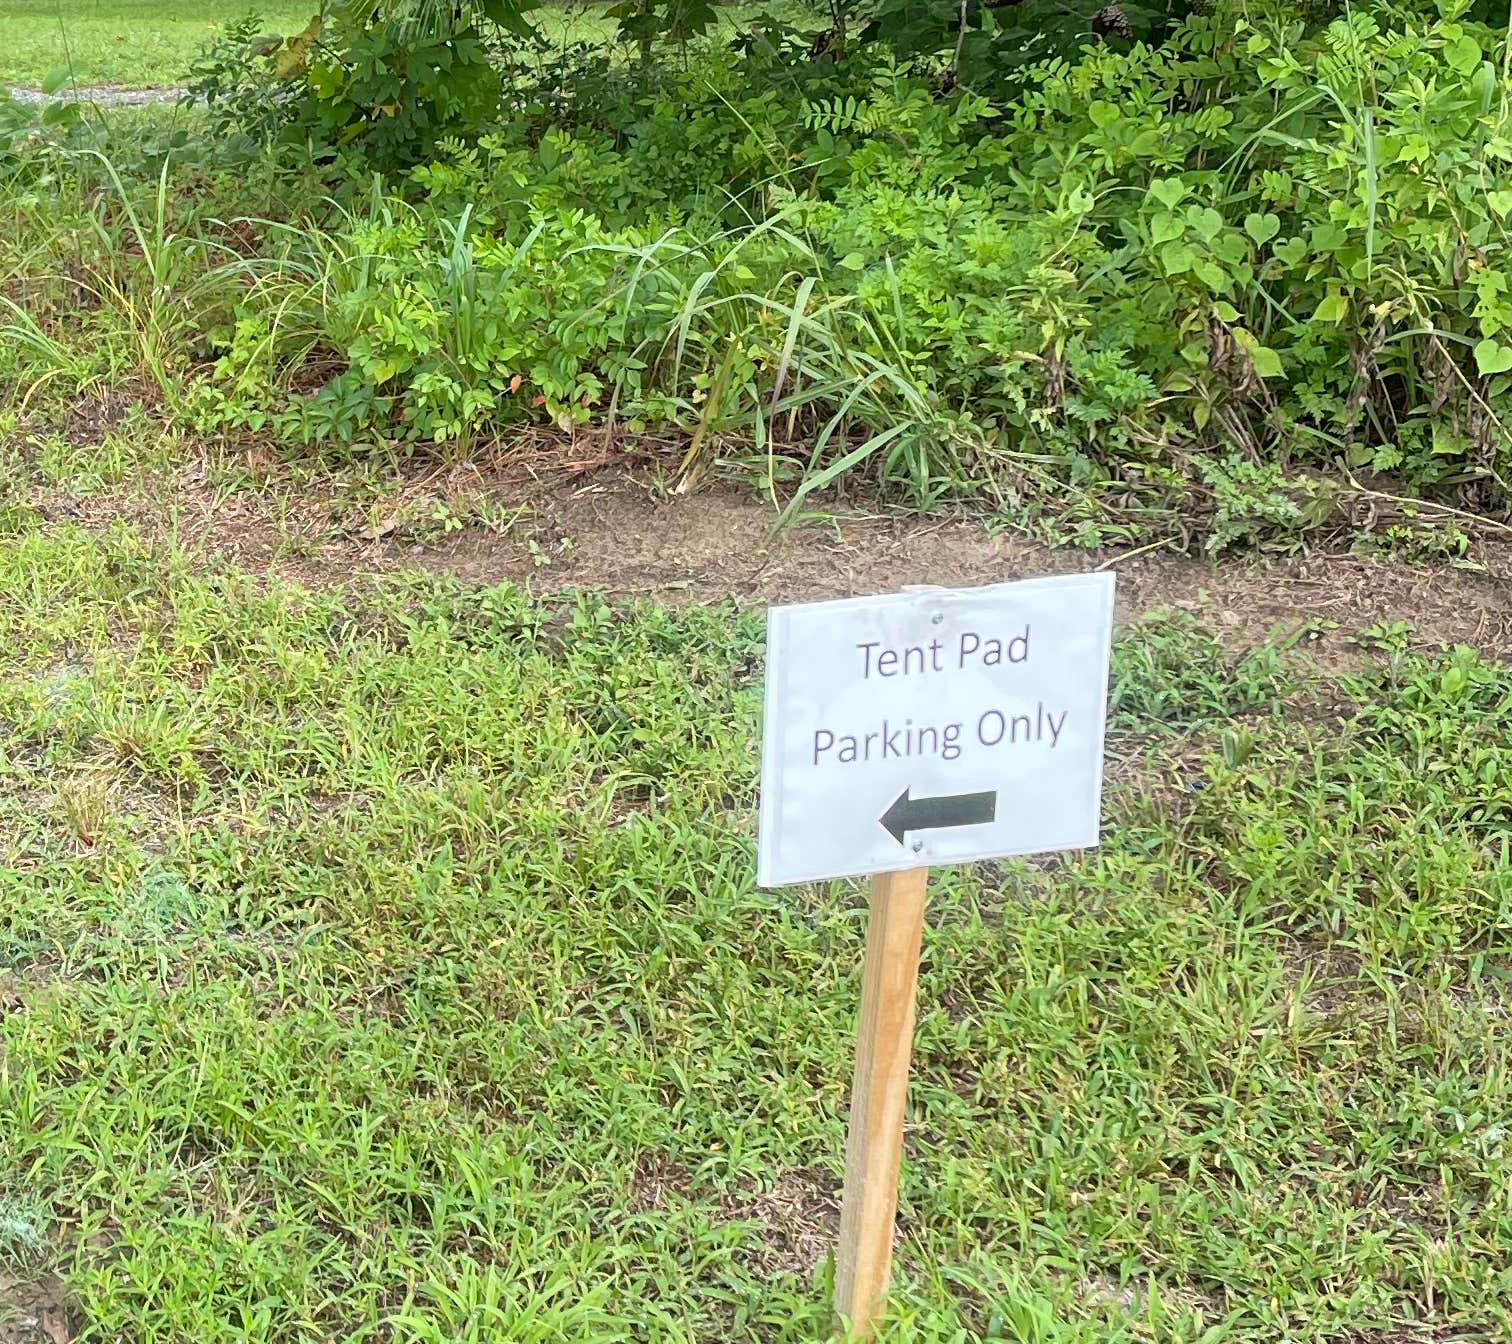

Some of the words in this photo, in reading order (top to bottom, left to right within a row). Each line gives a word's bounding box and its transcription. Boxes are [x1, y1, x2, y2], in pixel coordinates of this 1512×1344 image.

[856, 638, 943, 679] Tent
[958, 624, 1031, 669] Pad
[812, 719, 964, 765] Parking
[977, 702, 1068, 748] Only
